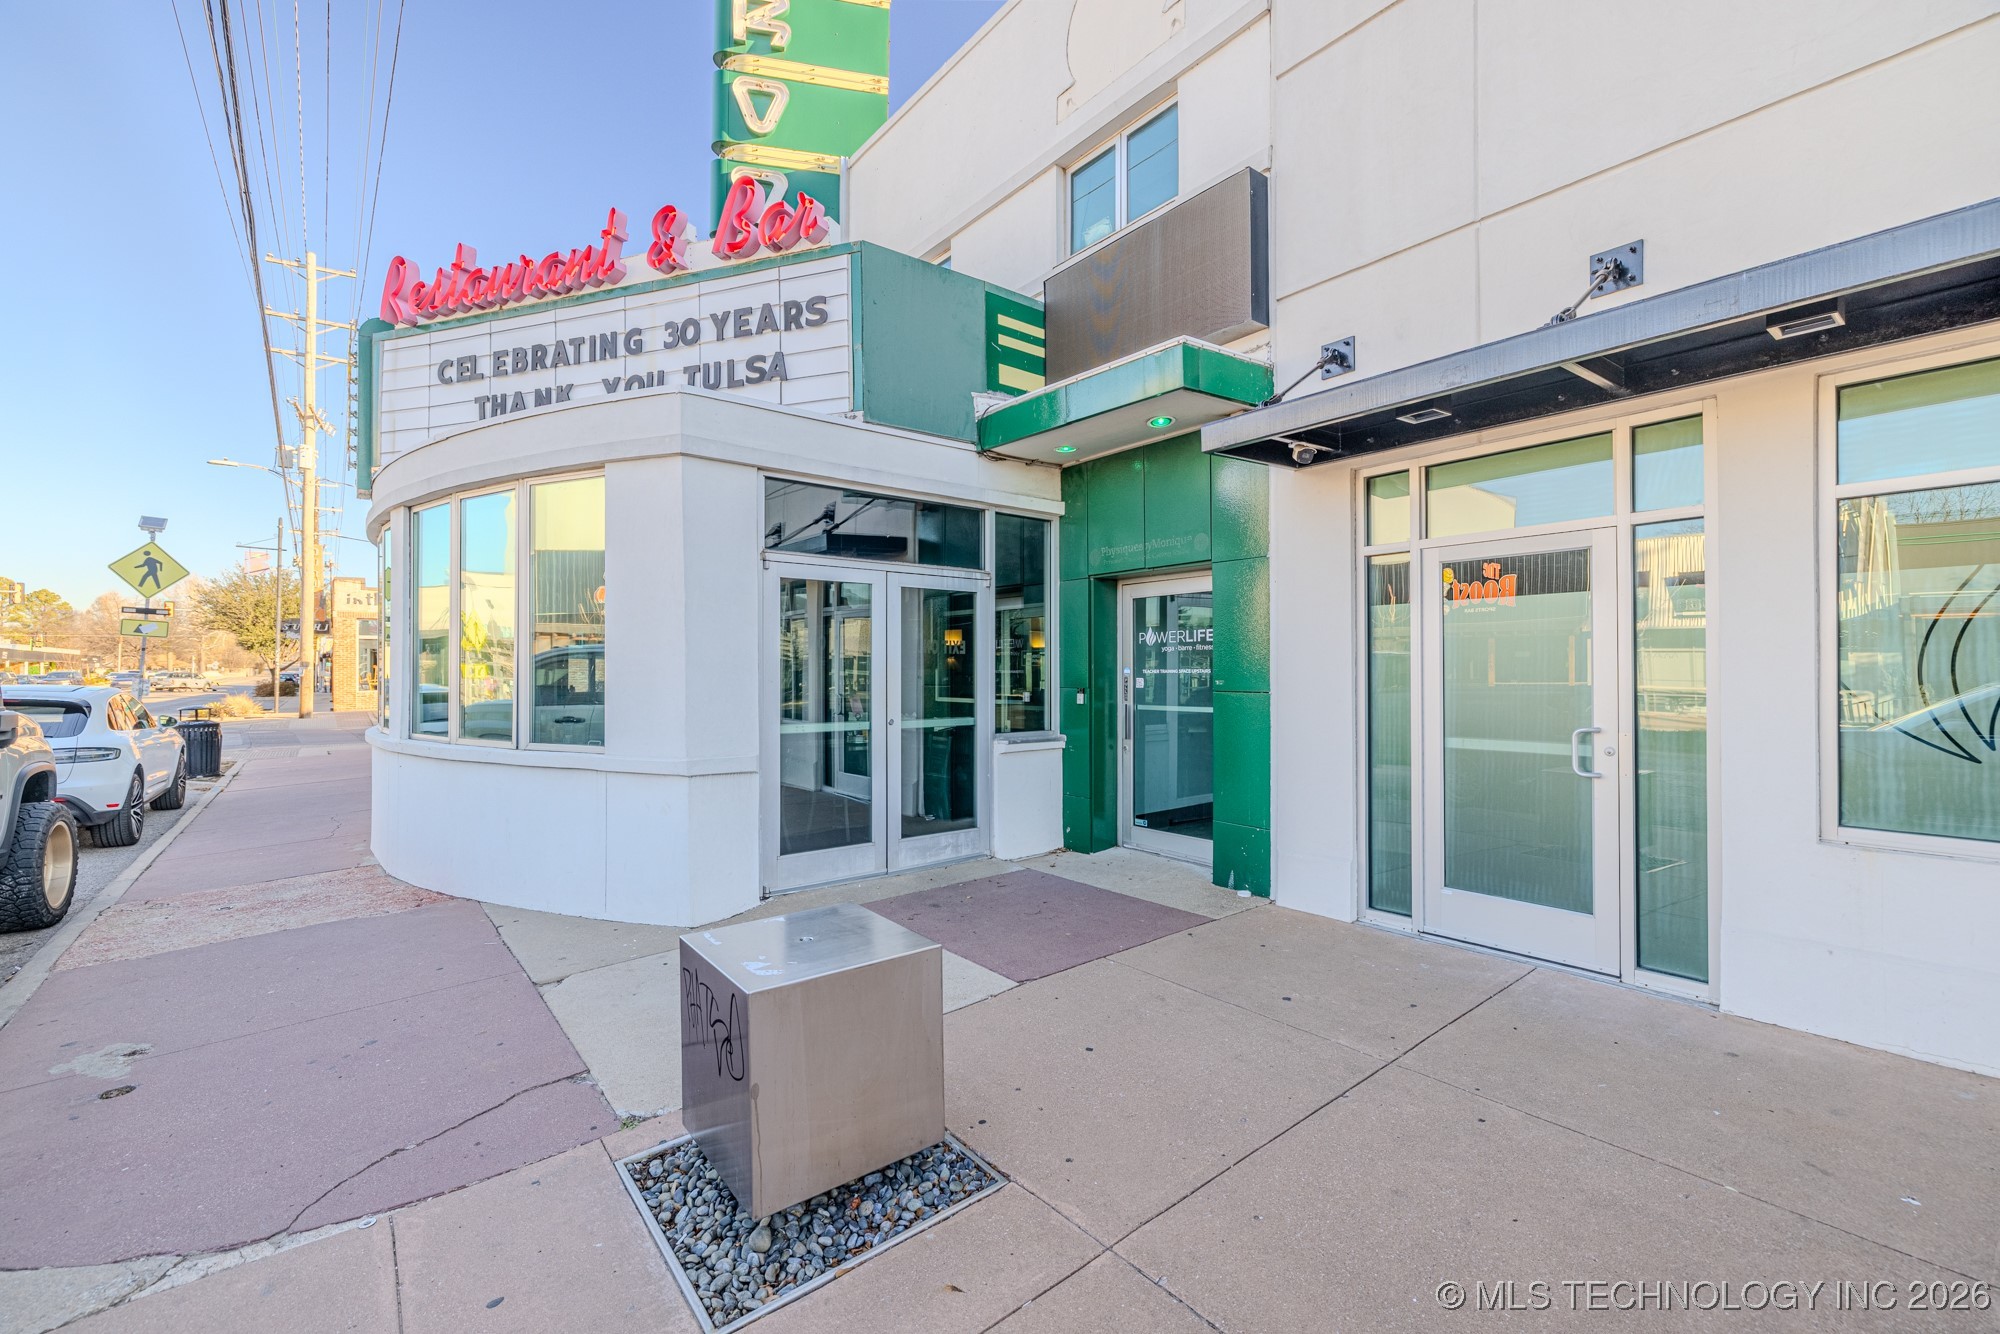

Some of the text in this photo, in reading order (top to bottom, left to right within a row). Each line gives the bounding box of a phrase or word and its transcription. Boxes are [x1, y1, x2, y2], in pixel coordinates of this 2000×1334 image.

[380, 176, 829, 326] Restaurant & Bar
[437, 295, 829, 385] CELEBRATING 30 YEARS
[474, 383, 574, 421] THANK
[683, 351, 788, 391] TULSA
[1161, 645, 1175, 653] yoga
